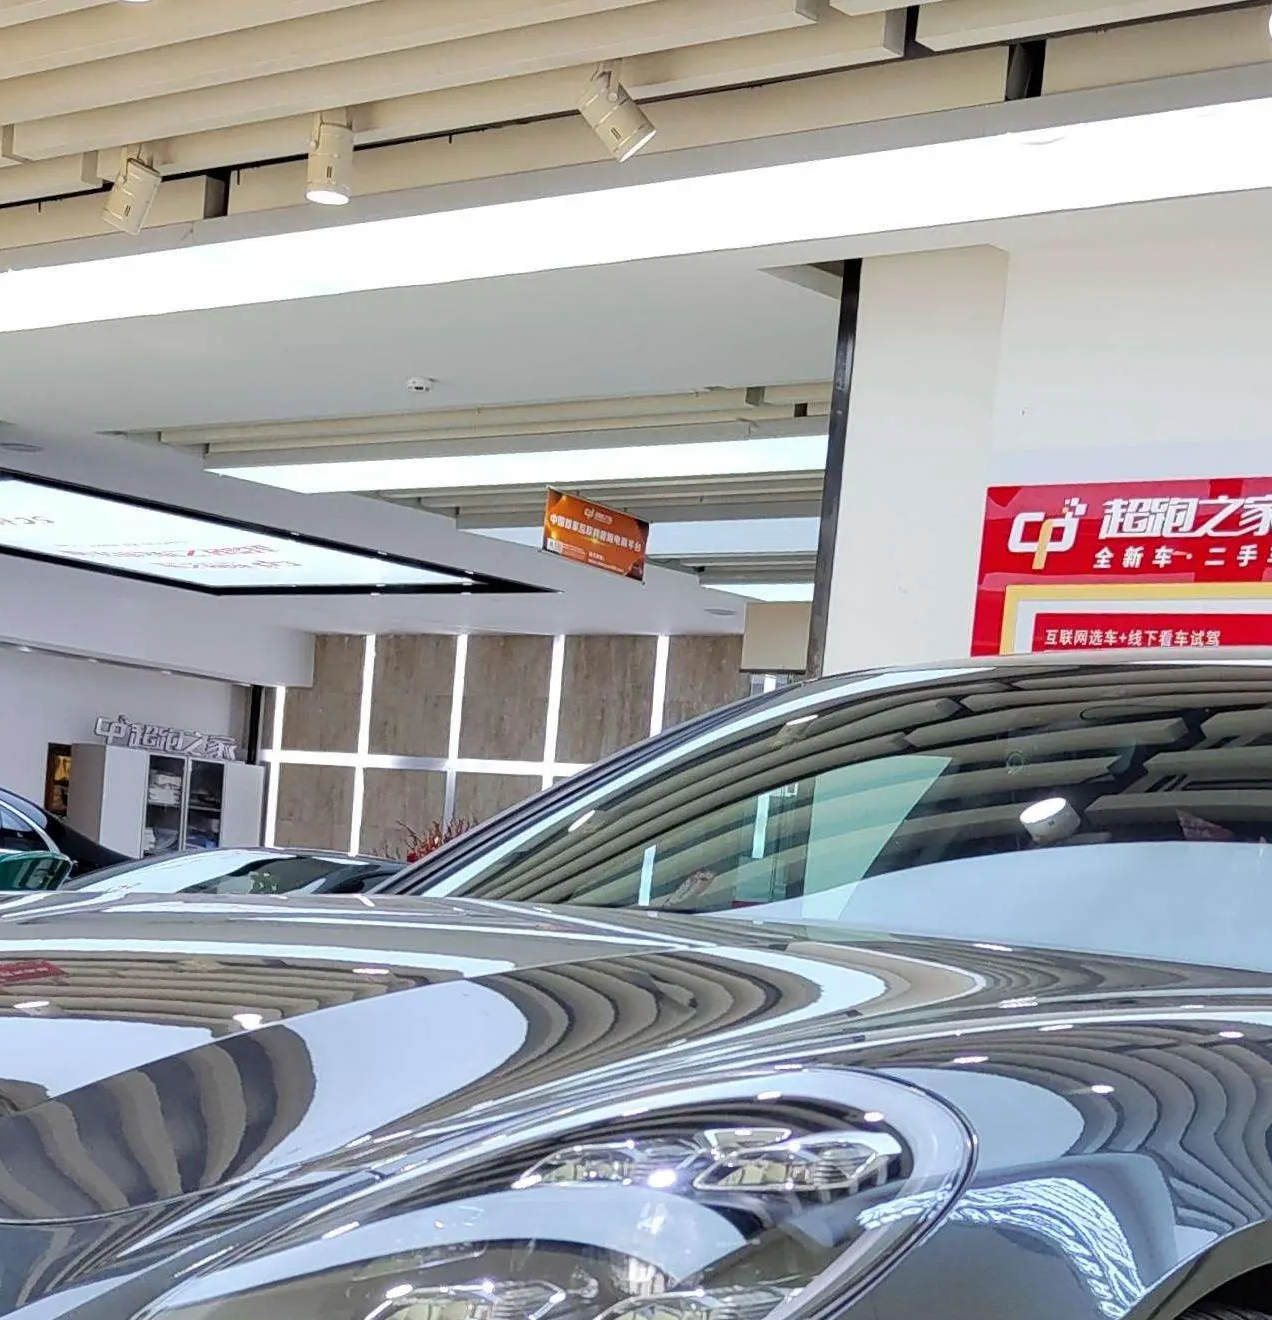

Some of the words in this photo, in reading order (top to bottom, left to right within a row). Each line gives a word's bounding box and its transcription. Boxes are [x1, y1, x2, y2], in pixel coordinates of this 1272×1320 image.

[1044, 628, 1224, 648] 互联网选车+线下看车试驾
